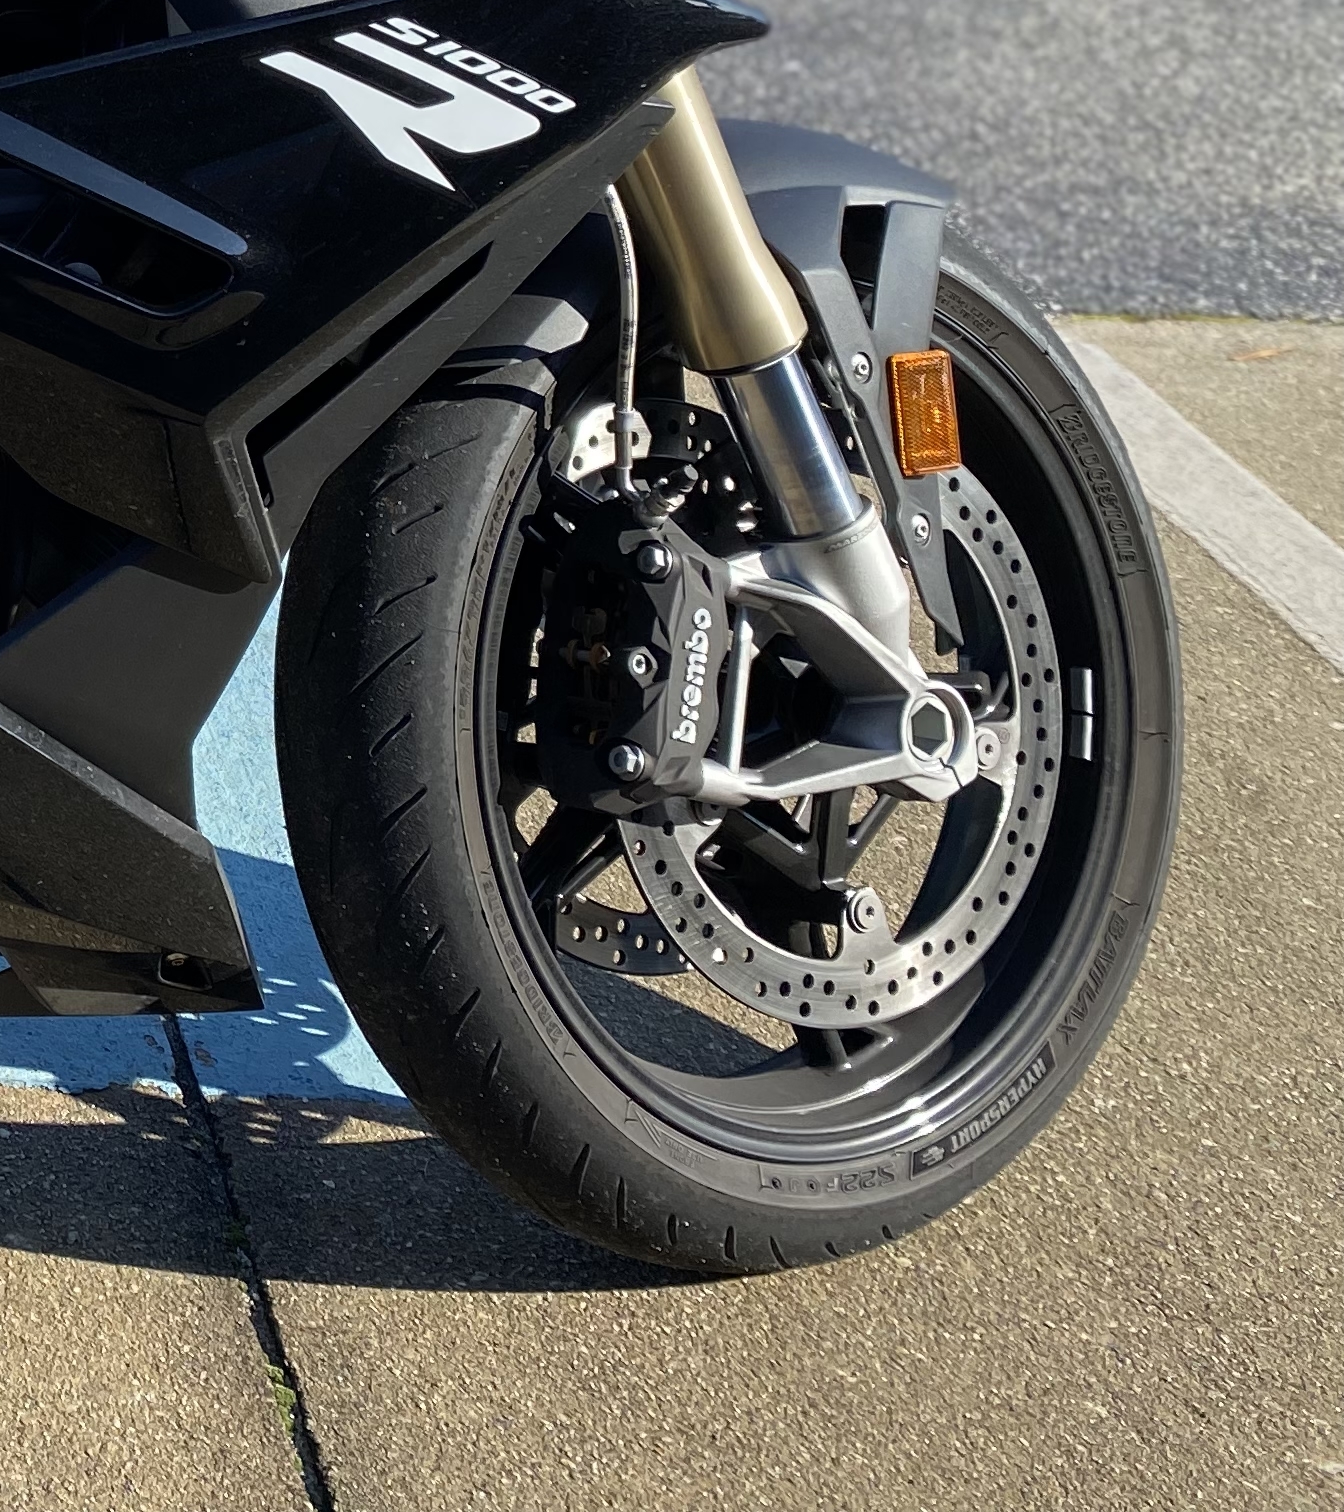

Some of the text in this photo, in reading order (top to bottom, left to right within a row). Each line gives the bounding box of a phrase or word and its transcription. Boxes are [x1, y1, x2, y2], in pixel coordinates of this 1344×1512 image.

[368, 17, 577, 113] S1000
[1056, 410, 1138, 564] BRIDGESTONE
[670, 607, 712, 745] brembo
[483, 881, 562, 1045] BRIDGESTONE
[1056, 910, 1131, 1046] BATTLAX
[950, 1057, 1047, 1153] HYPERSPORT
